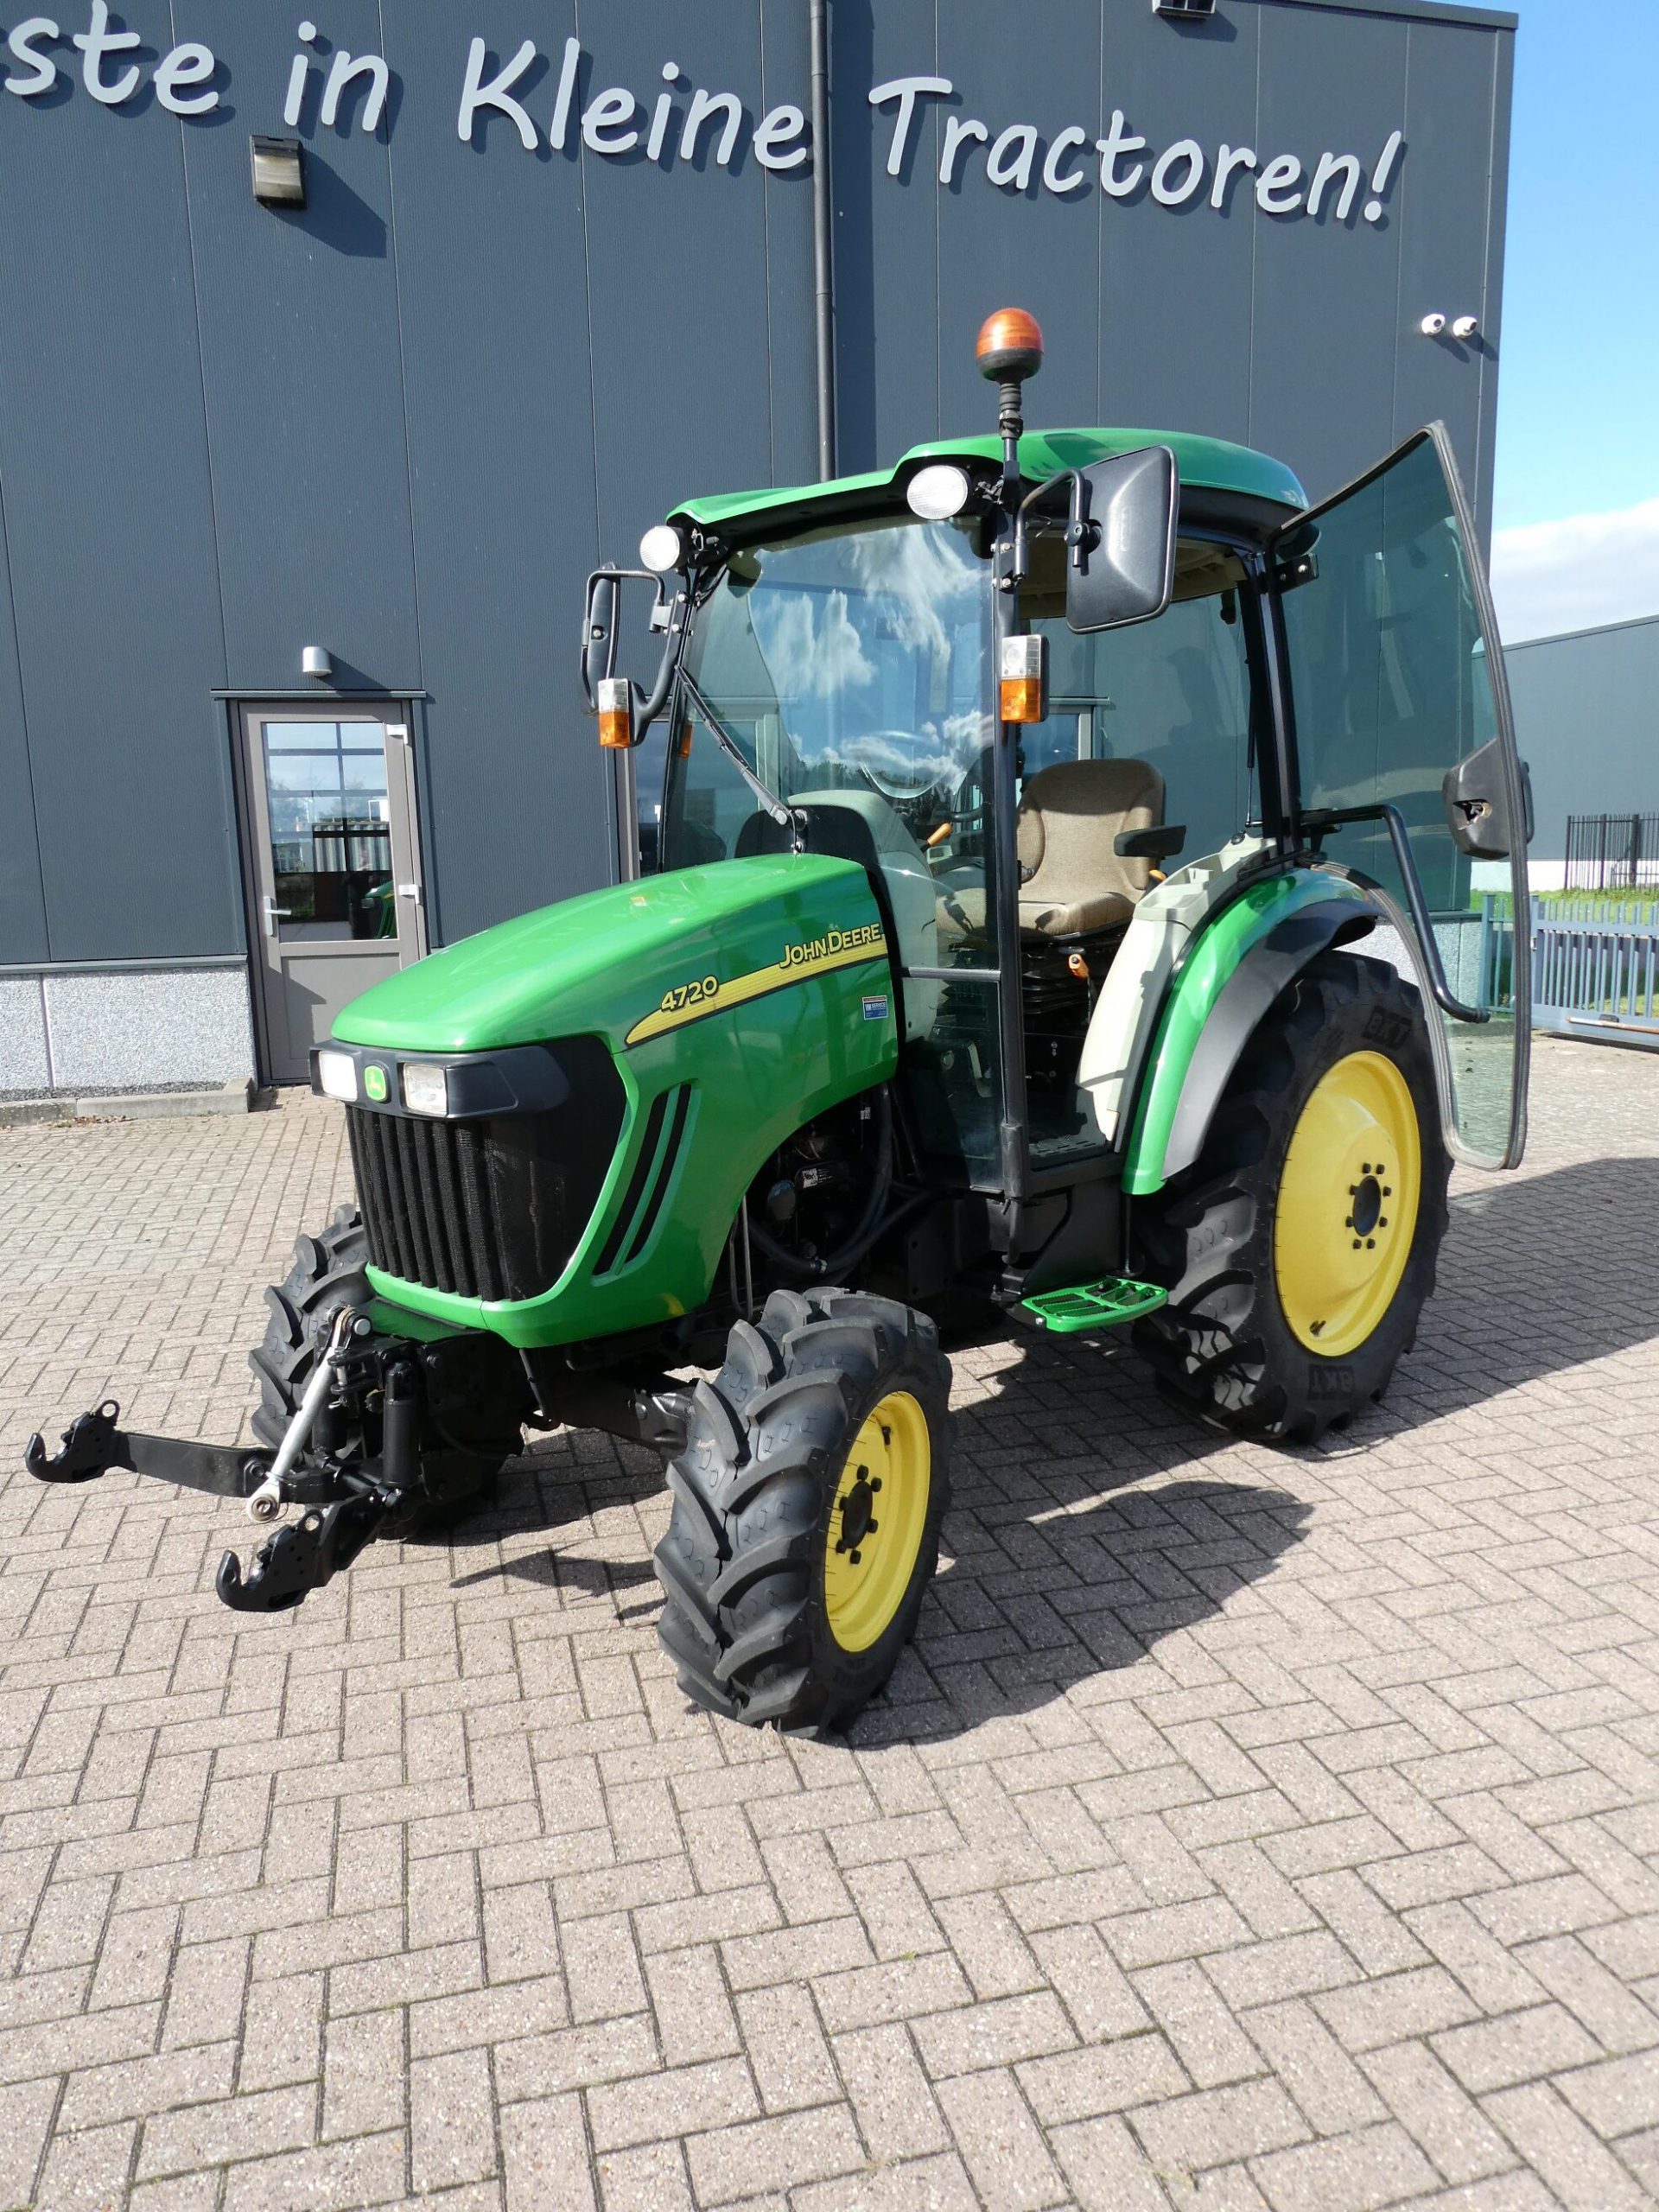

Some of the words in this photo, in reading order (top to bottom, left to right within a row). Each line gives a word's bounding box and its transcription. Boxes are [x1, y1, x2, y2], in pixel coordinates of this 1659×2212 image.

[284, 21, 389, 132] in
[457, 37, 808, 169] Kleine
[868, 76, 1402, 222] Tractoren!
[779, 938, 828, 969] JOHN
[827, 923, 881, 953] DEERE
[660, 975, 719, 1011] 4720
